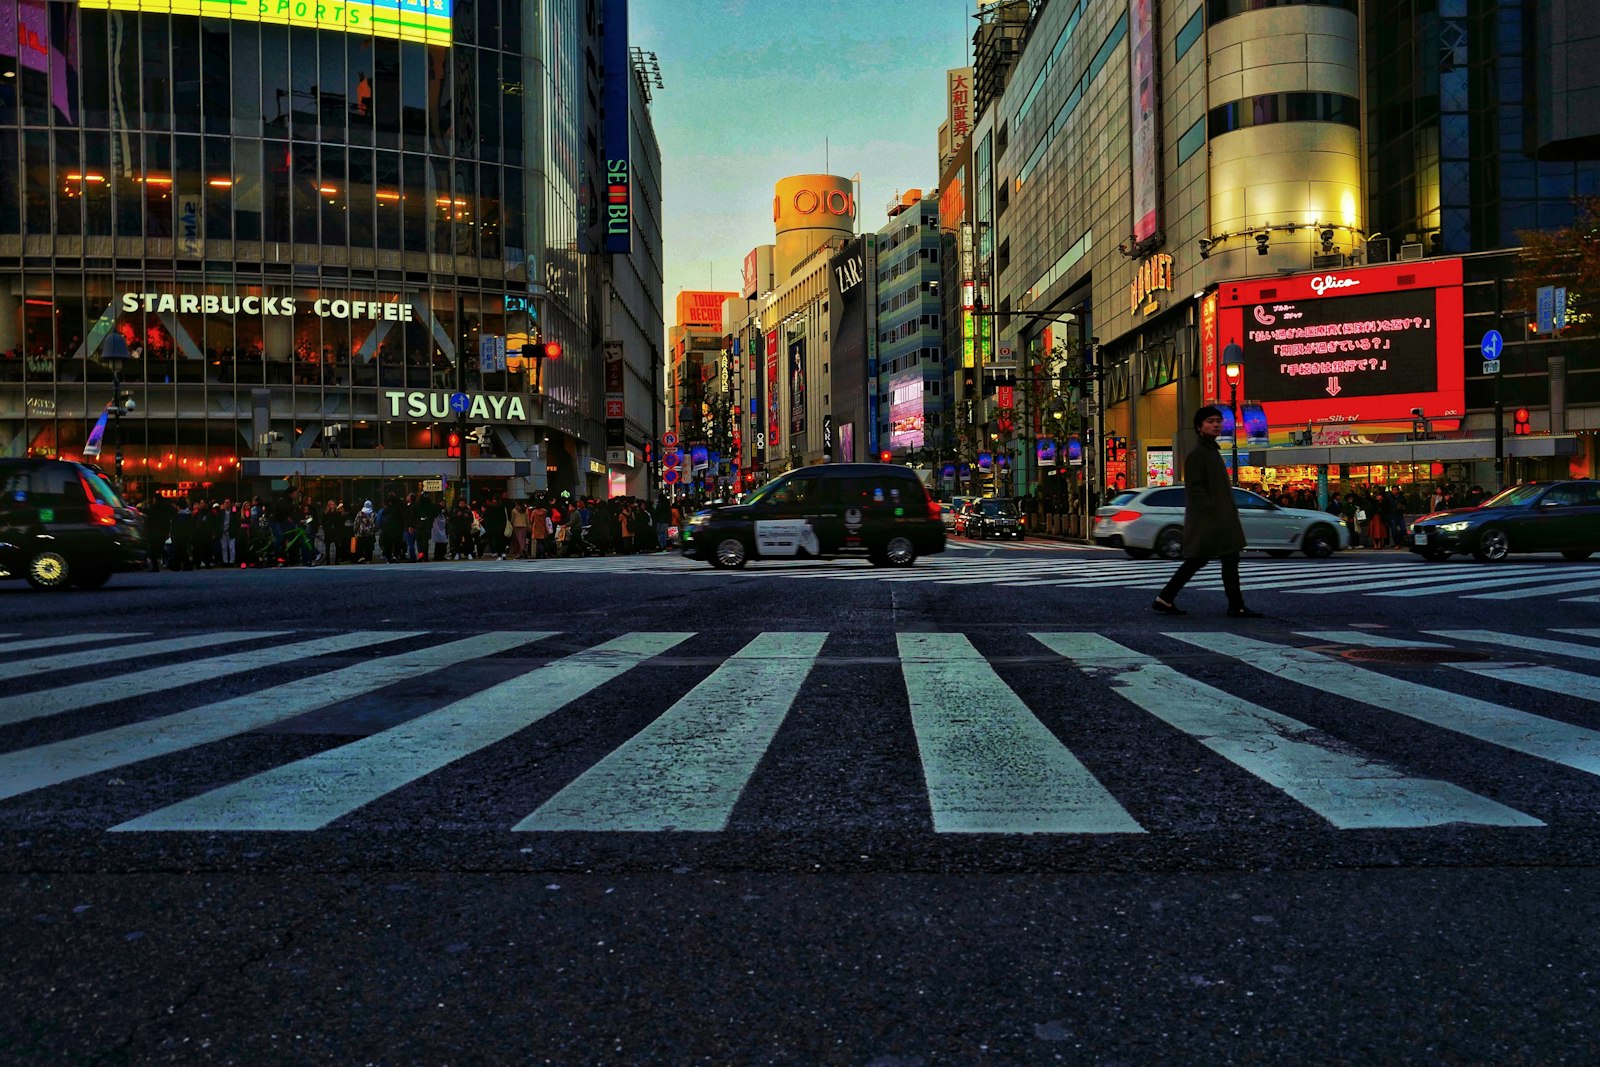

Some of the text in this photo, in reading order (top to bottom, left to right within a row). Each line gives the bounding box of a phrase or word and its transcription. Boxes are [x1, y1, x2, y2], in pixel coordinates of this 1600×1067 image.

[260, 0, 360, 24] SPORTS
[953, 75, 969, 138] 大和証券
[1130, 253, 1173, 316] MAGNET
[1310, 275, 1360, 296] Glico
[122, 292, 413, 322] STARBUCKS COFFEE
[693, 294, 724, 308] TOWER
[721, 348, 729, 393] KARAOKE
[385, 391, 526, 421] TSUAYA
[609, 403, 621, 415] 本
